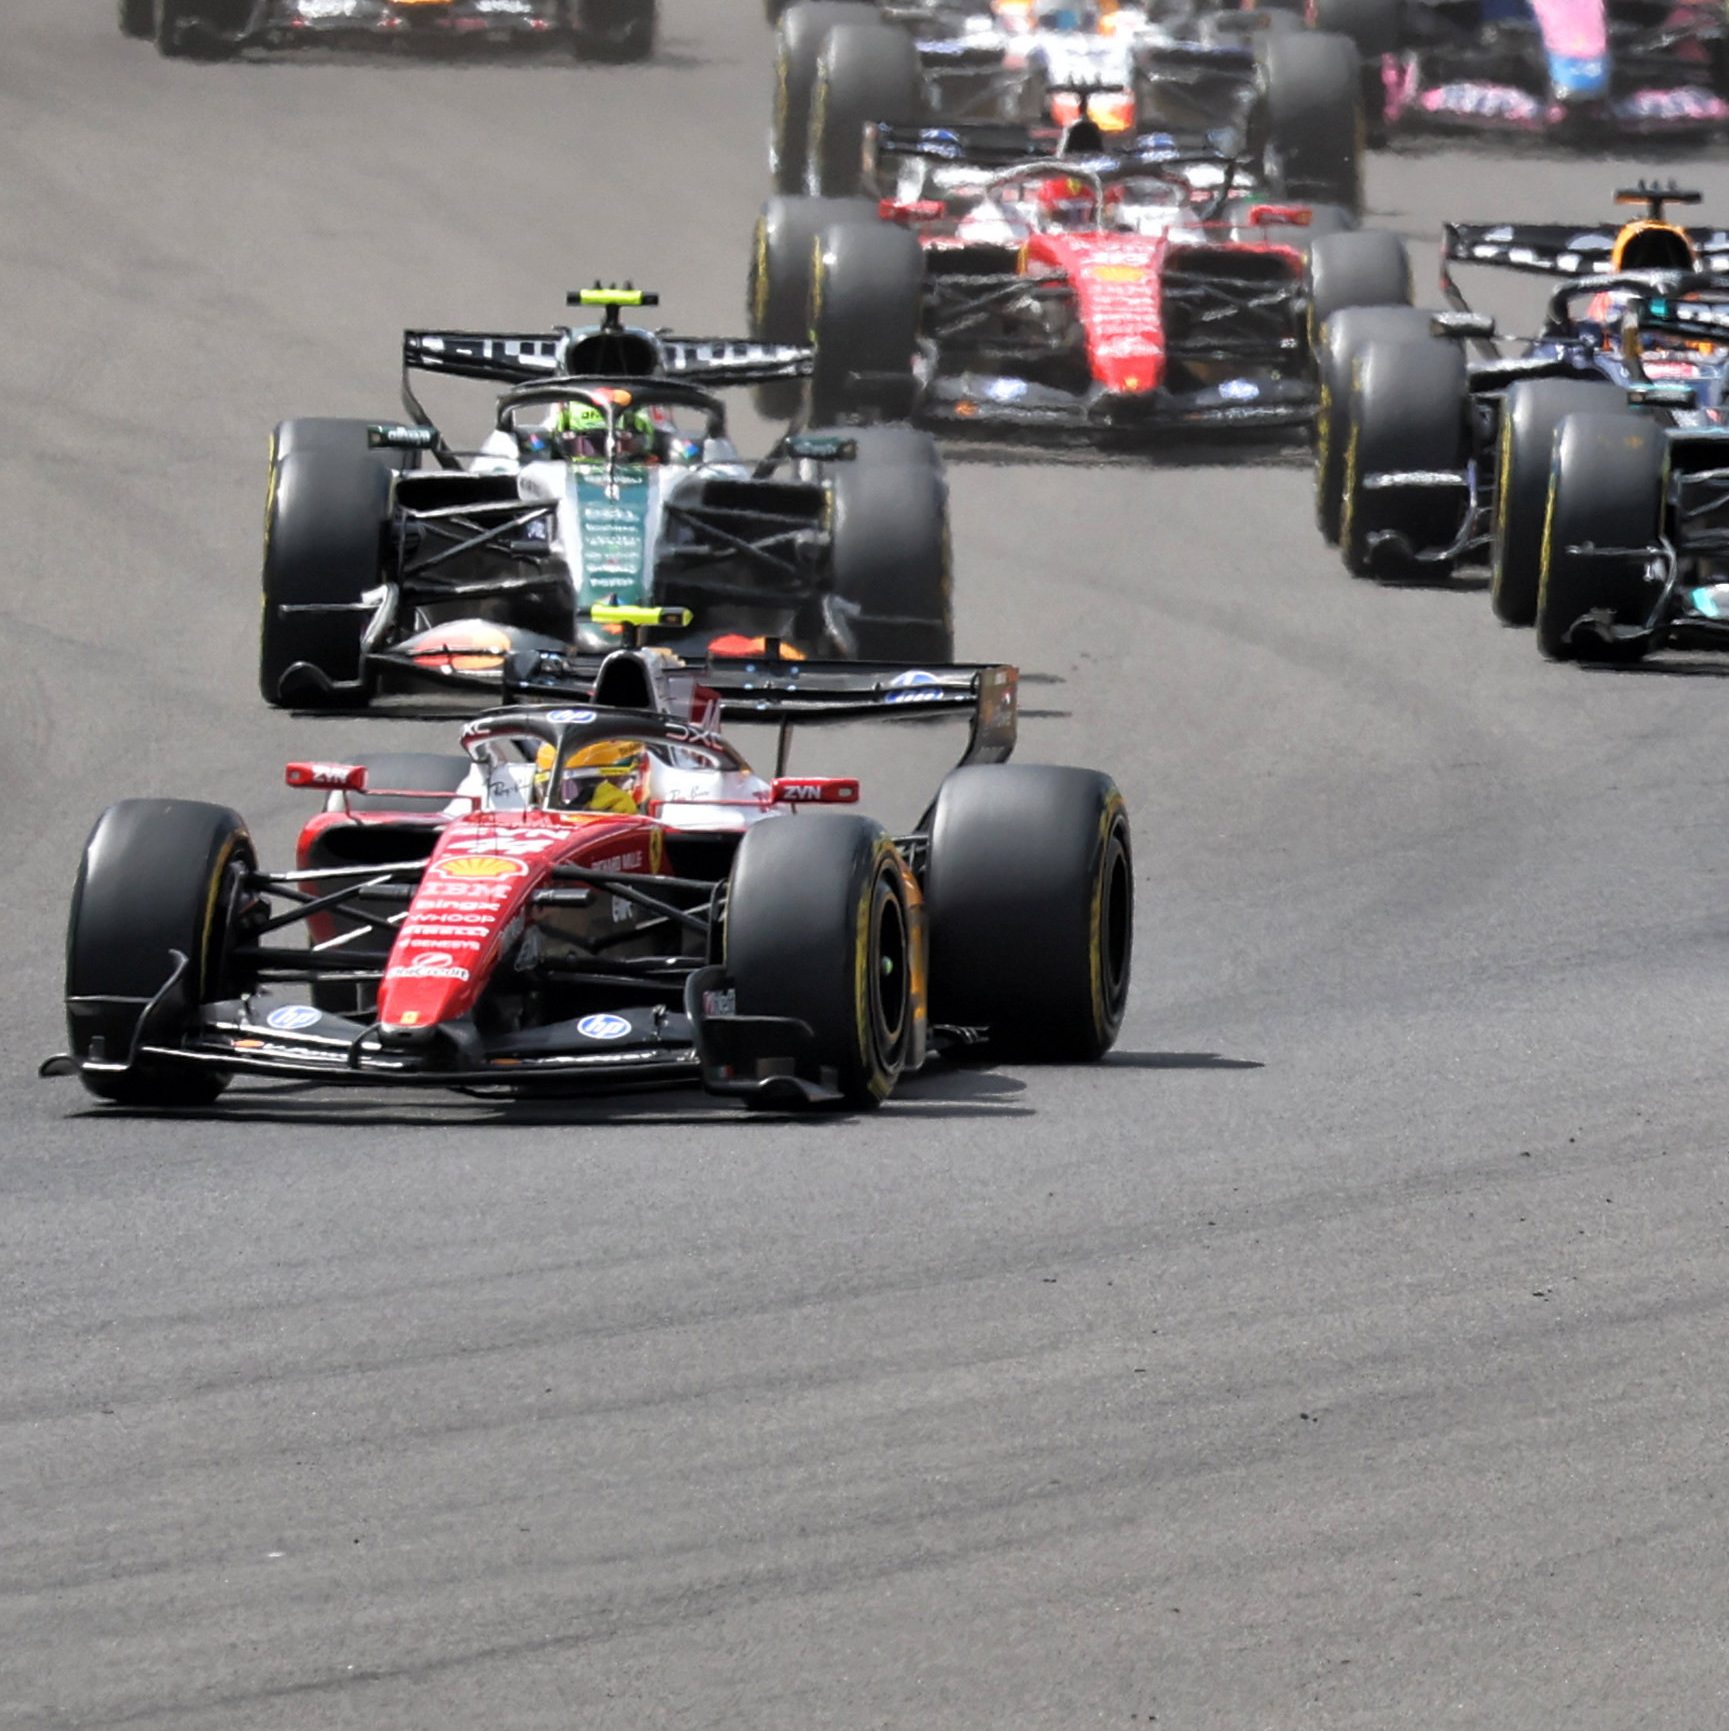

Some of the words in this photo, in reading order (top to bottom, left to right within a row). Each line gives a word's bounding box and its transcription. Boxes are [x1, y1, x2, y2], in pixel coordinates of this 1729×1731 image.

[782, 785, 822, 800] ZYN
[421, 883, 512, 900] IBM
[408, 913, 496, 923] WHOOP
